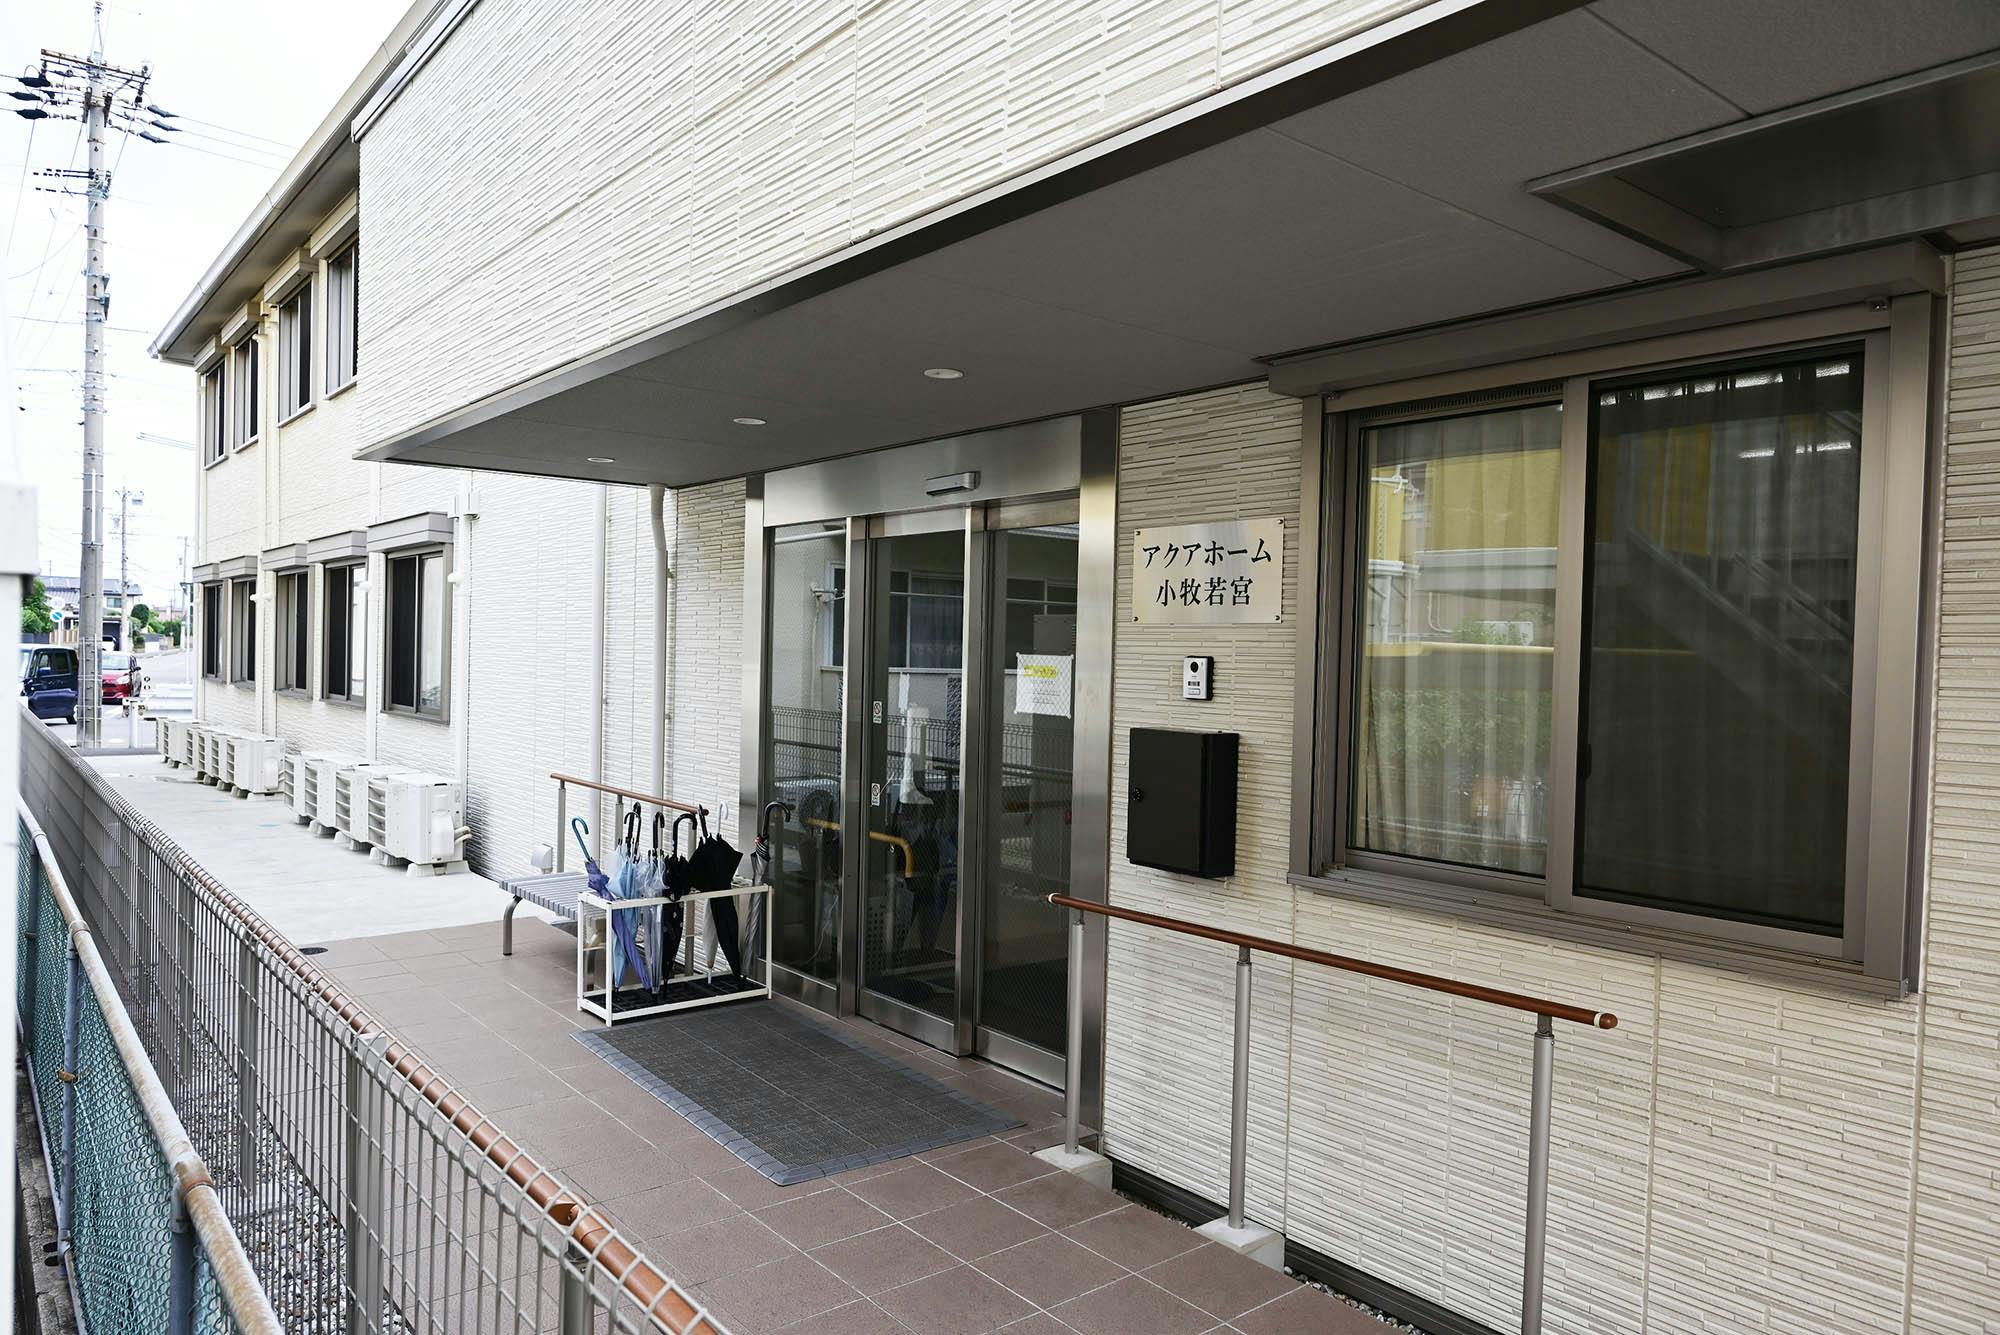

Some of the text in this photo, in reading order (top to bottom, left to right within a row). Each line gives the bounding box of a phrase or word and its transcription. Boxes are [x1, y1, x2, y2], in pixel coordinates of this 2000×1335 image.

[1142, 538, 1272, 568] アクアホーム
[1156, 576, 1253, 606] 小牧若宮
